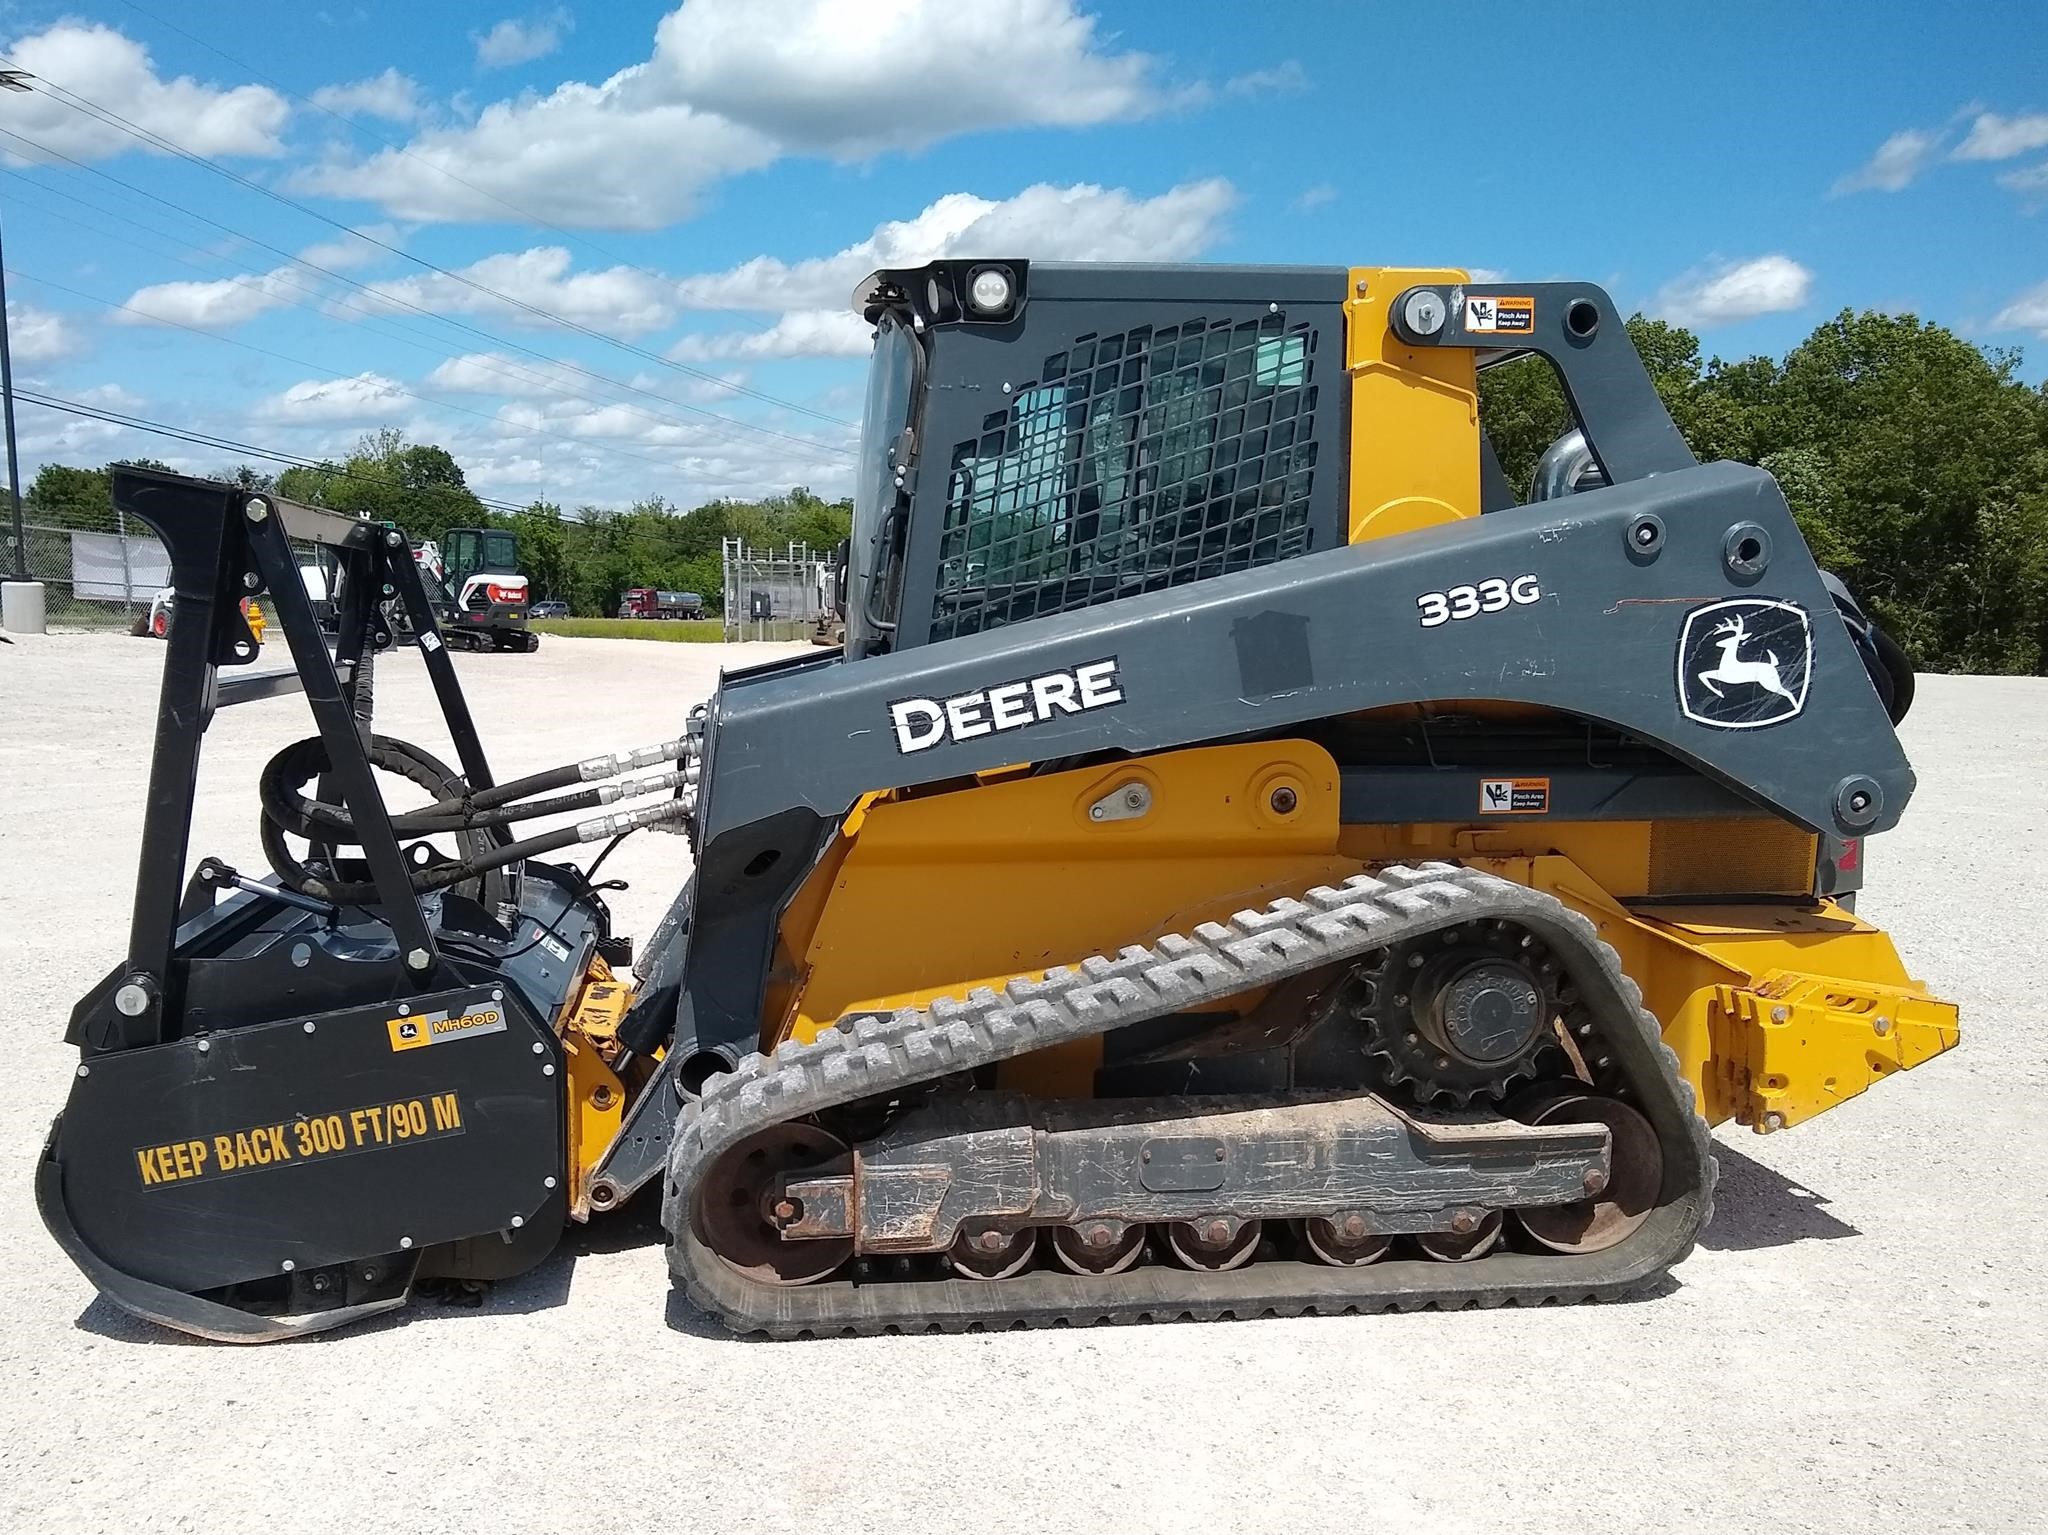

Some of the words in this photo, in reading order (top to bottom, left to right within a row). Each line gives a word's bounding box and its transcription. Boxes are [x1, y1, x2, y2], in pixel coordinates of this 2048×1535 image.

[1417, 574, 1541, 627] 333G
[890, 660, 1122, 754] DEERE
[433, 1011, 500, 1034] MH60D
[137, 1141, 207, 1185] KEEP
[214, 1125, 291, 1171] BACK
[294, 1115, 346, 1157] 300
[350, 1100, 427, 1146] FT/90
[431, 1093, 461, 1131] M
